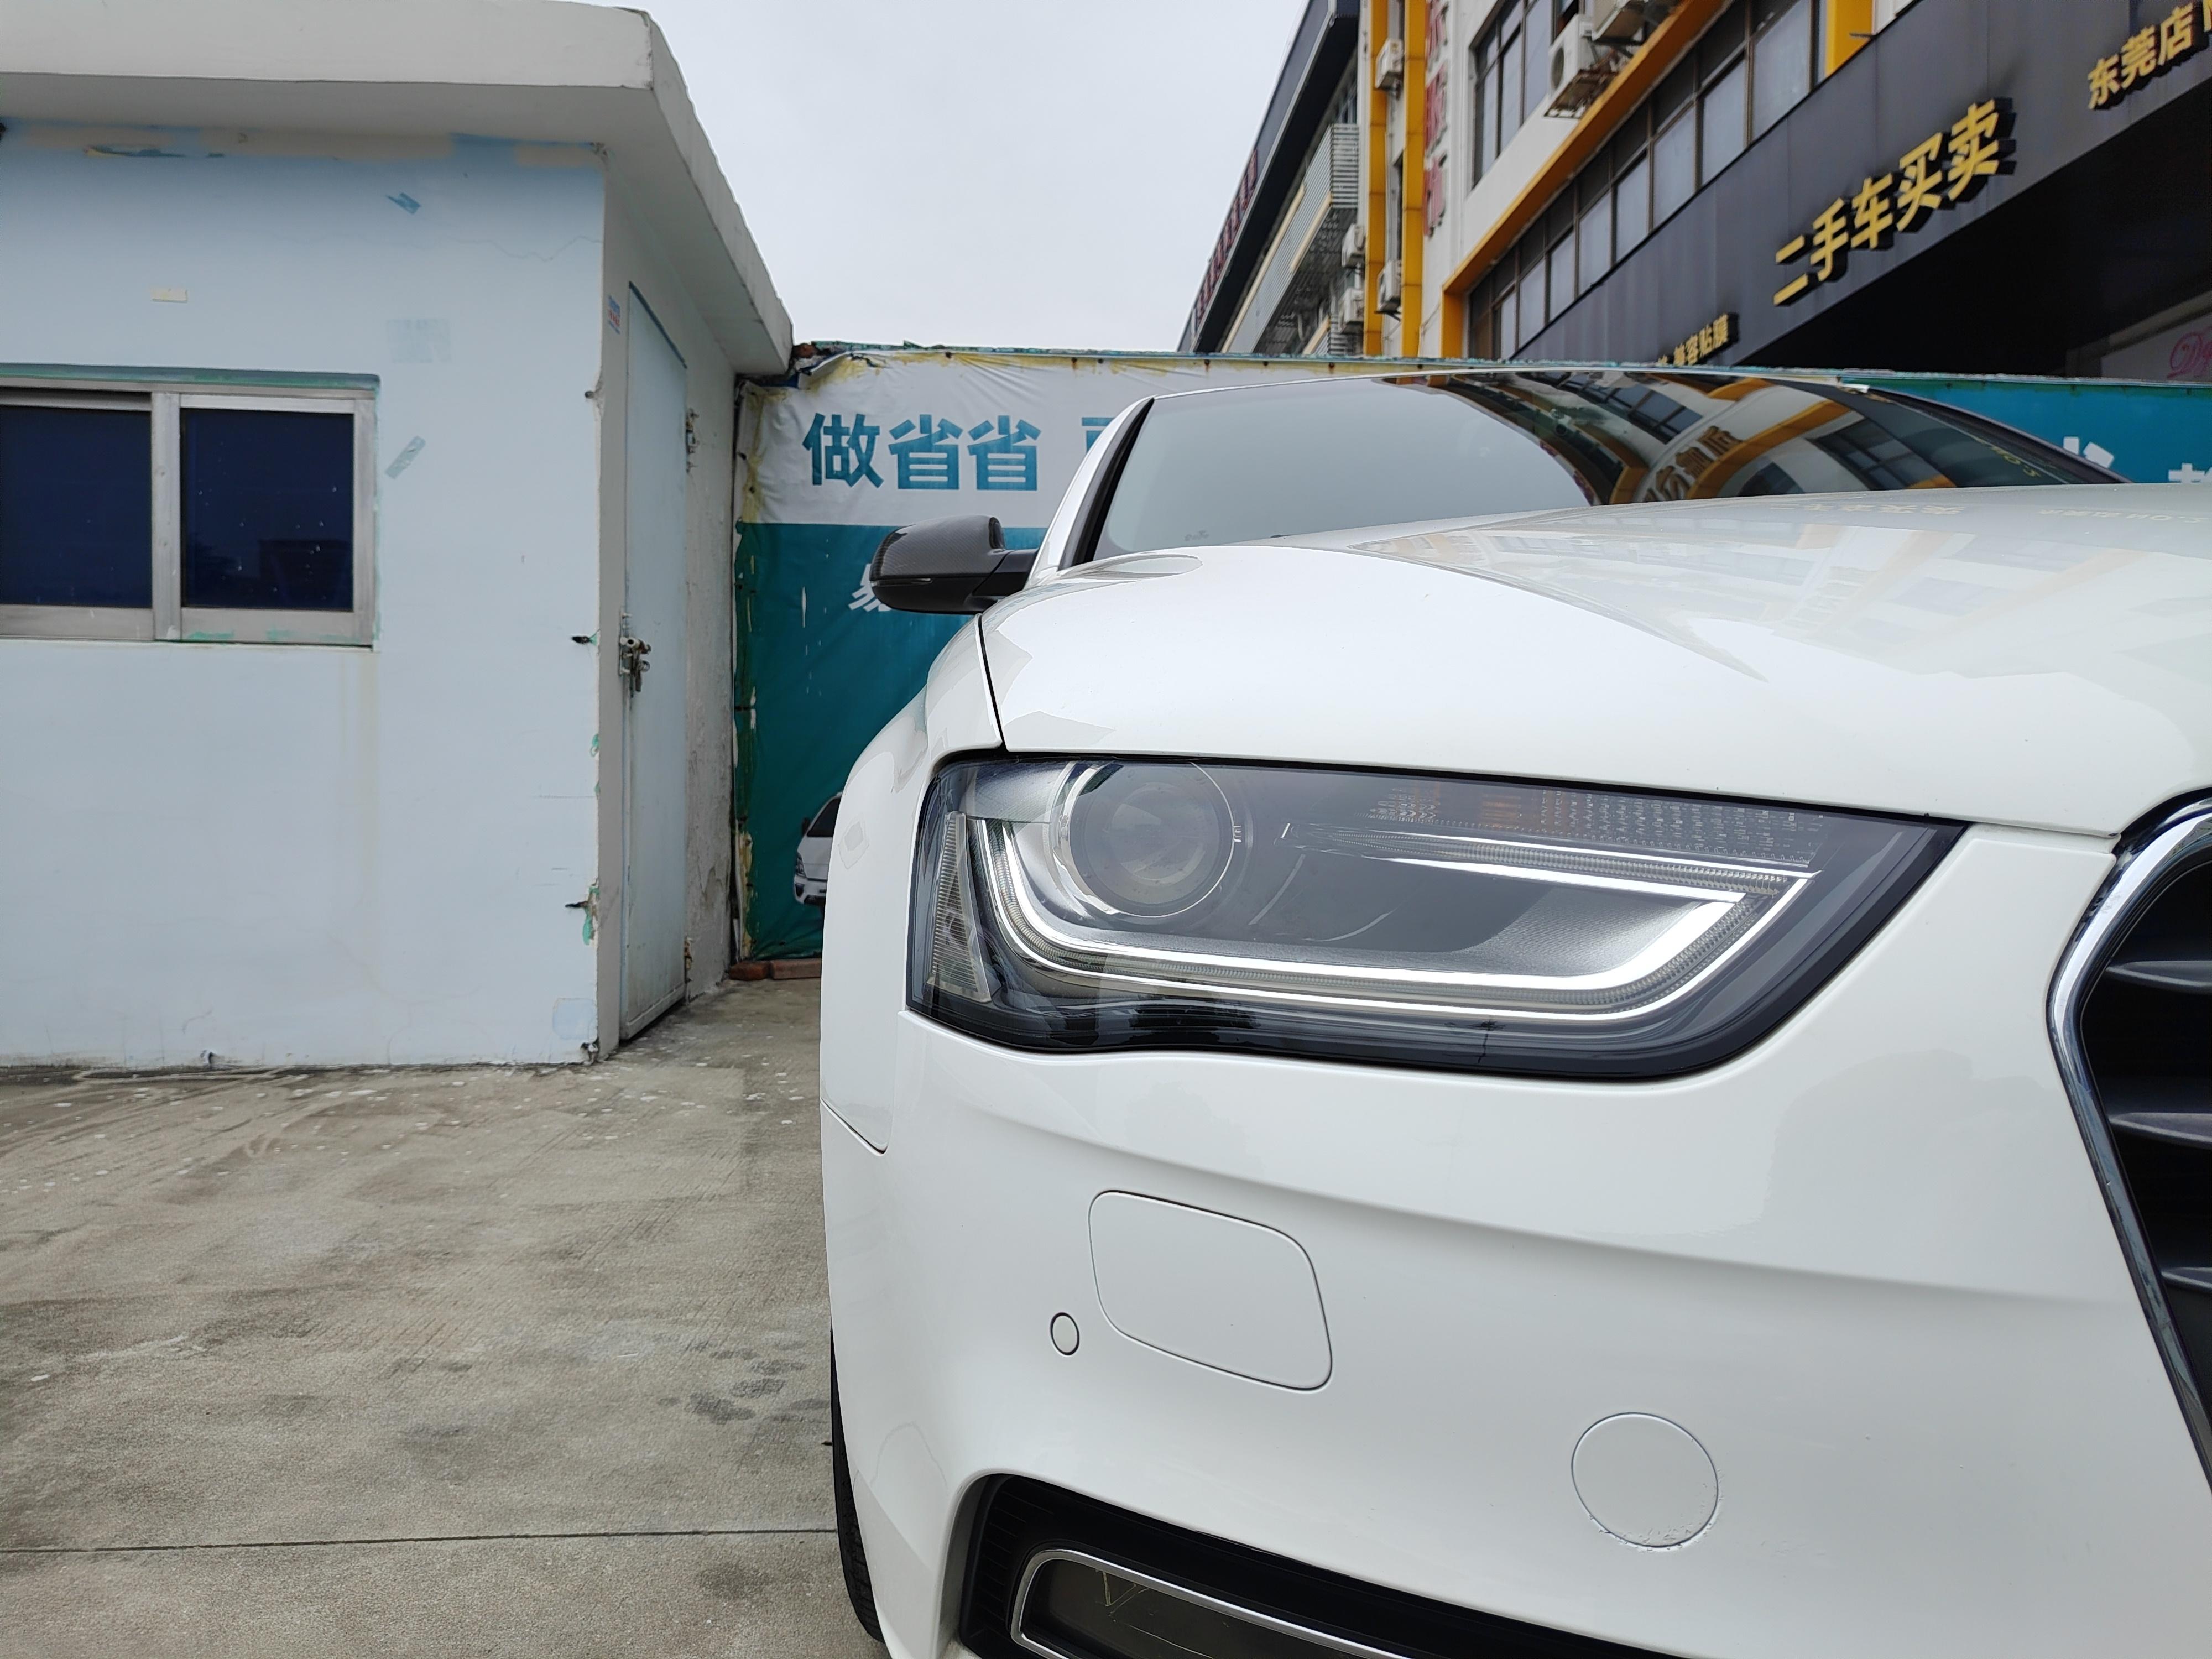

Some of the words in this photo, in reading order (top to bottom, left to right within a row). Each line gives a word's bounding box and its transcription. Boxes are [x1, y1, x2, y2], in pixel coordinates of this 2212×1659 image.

[2088, 2, 2193, 109] 东莞店
[1773, 98, 1999, 306] 二手车买卖
[802, 412, 1042, 491] 做省省
